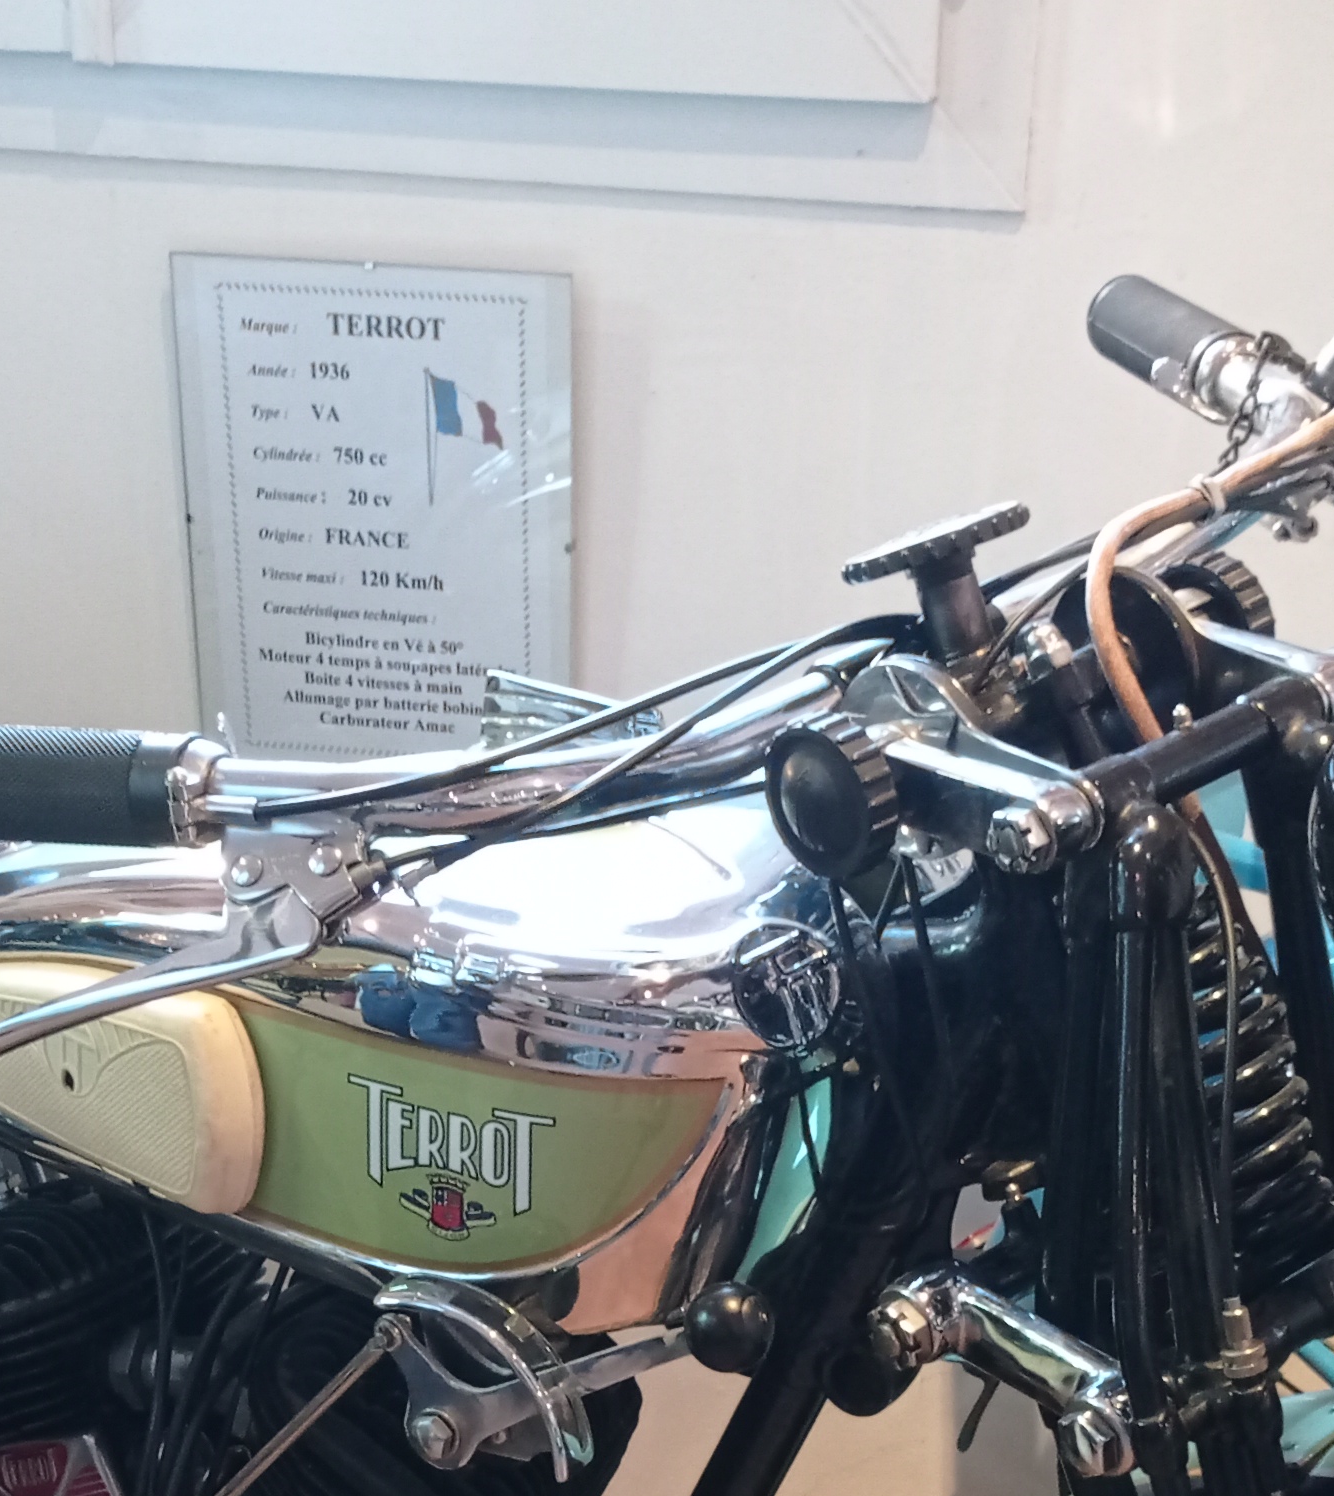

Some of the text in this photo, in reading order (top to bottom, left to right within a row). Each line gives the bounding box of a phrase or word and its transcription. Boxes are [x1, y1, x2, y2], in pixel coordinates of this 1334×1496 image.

[239, 316, 289, 336] Marque
[326, 312, 445, 341] TERROT
[248, 364, 288, 379] Année
[310, 361, 350, 381] 1936
[251, 404, 280, 422] Type
[311, 403, 340, 422] VA
[253, 446, 313, 463] Cylindrée
[333, 446, 364, 466] 750
[369, 451, 388, 466] cc
[256, 487, 317, 504] Puissance
[348, 488, 368, 506] 20
[373, 493, 393, 507] cv
[258, 527, 305, 544] Origine
[325, 527, 410, 549] FRANCE
[261, 567, 302, 583] Vitesse
[306, 572, 337, 584] maxi
[361, 569, 390, 588] 120
[396, 571, 444, 592] Km/h
[263, 601, 360, 621] Caractéristiques
[363, 608, 428, 626] techniques
[305, 631, 379, 650] Bicylindre
[383, 640, 399, 651] en
[428, 640, 436, 654] à
[259, 647, 312, 664] Moteur
[316, 651, 323, 665] 4
[328, 655, 370, 671] temps
[374, 656, 383, 670] à
[387, 660, 452, 677] soupapes
[345, 674, 353, 687] 4
[357, 675, 410, 691] vitesses
[414, 680, 422, 692] à
[427, 681, 463, 695] main
[284, 688, 351, 709] Allumage
[355, 697, 379, 711] par
[383, 696, 439, 713] batterie
[320, 711, 455, 734] Carburateur Amac
[346, 1072, 556, 1217] TERROT
